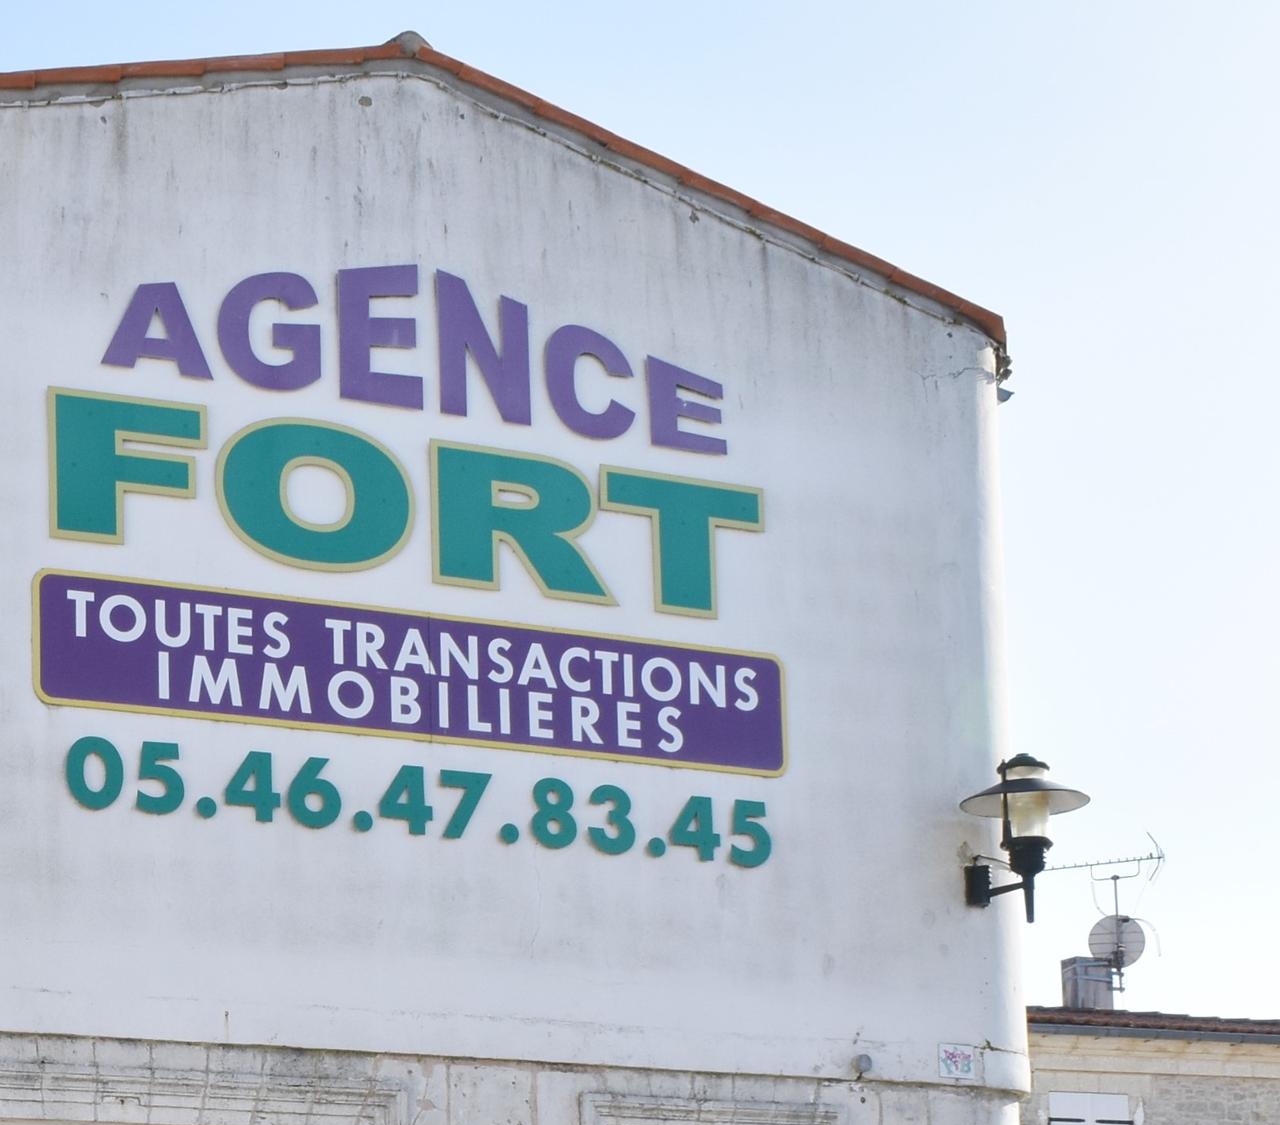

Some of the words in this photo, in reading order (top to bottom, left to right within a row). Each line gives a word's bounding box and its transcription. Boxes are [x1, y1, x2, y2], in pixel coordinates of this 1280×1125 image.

[100, 263, 728, 456] AGENCE
[47, 385, 765, 620] FORT
[66, 588, 292, 660] TOUTES
[325, 617, 760, 712] TRANSACTIONS
[157, 651, 685, 753] IMMOBILIERES
[65, 735, 773, 869] 05.46.47.83.45
